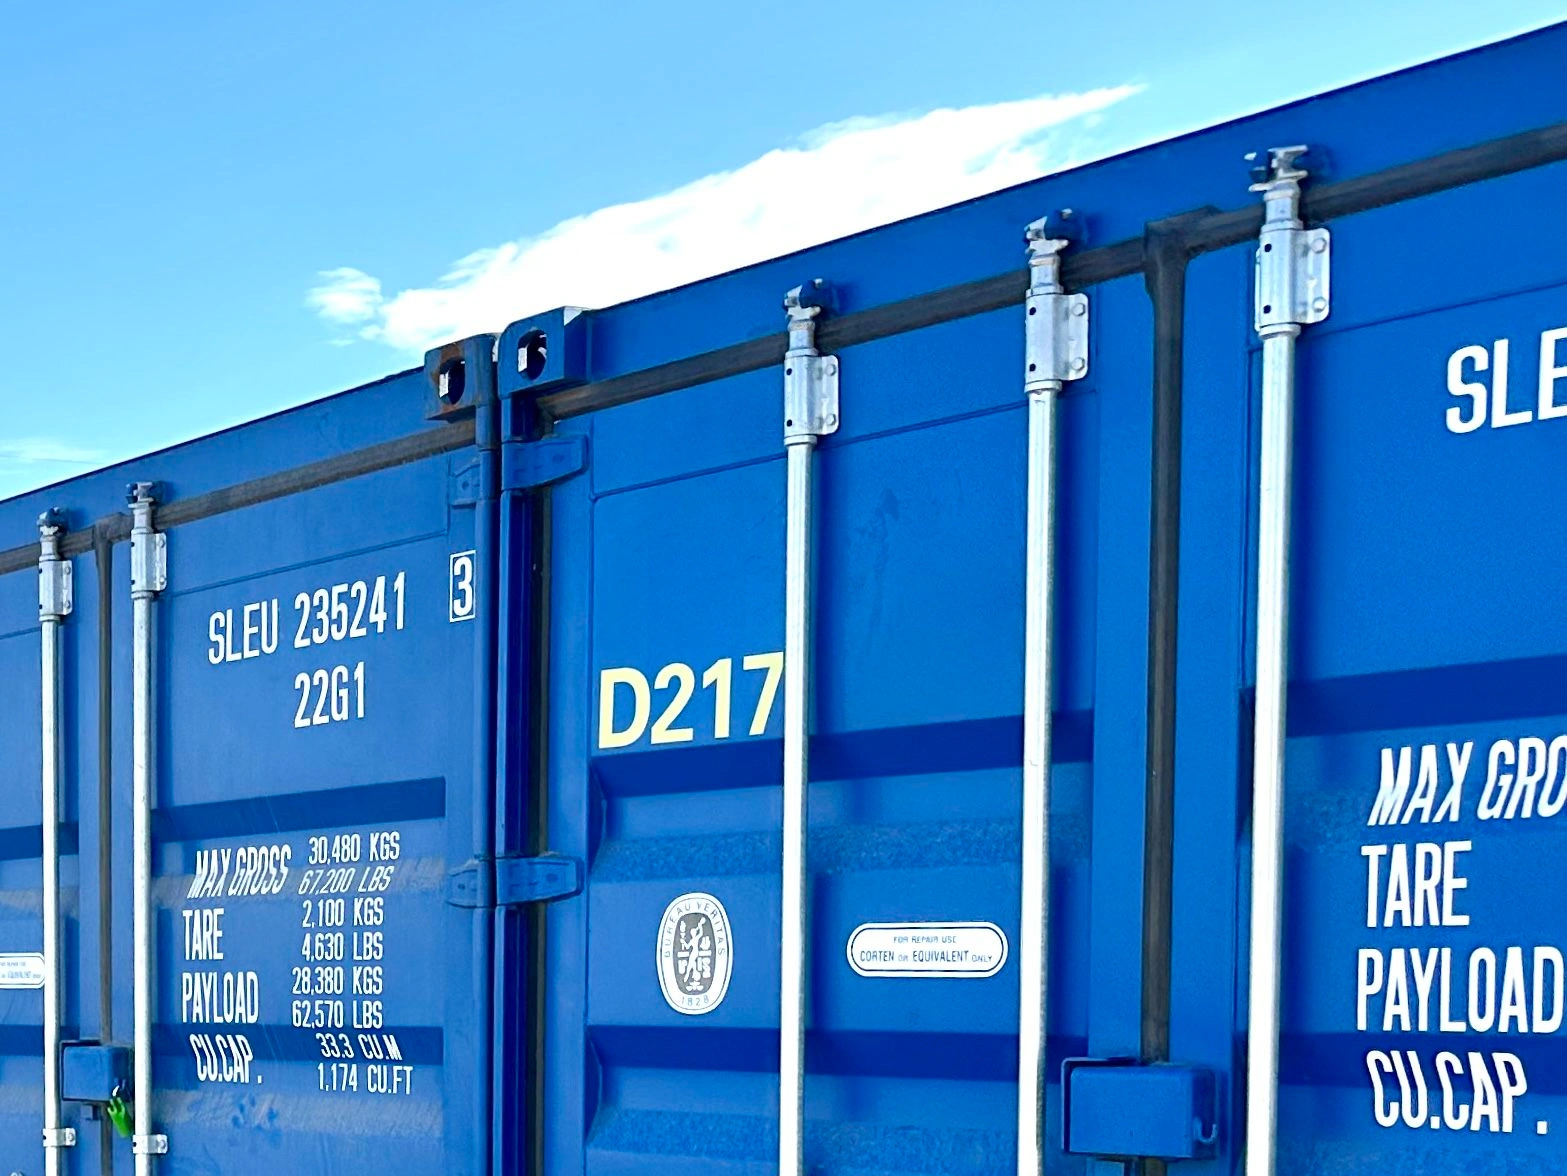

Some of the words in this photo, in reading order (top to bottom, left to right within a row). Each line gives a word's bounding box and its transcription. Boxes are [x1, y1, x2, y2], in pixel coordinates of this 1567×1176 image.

[1446, 326, 1567, 433] SLE
[208, 598, 278, 664] SLEU
[294, 571, 405, 649] 235241
[294, 661, 365, 728] 22G1
[598, 651, 784, 749] D217
[1367, 742, 1474, 826] MAX
[1477, 735, 1567, 820] GRO
[369, 831, 400, 862] KGS
[186, 848, 231, 899] MAX
[228, 844, 292, 897] GROSS
[358, 865, 395, 893] LBS
[1361, 840, 1472, 928] TARE
[353, 897, 384, 926] KGS
[664, 902, 691, 957] BUREAU
[696, 902, 726, 957] VERITAS
[182, 908, 224, 960] TARE
[353, 932, 383, 961] LBS
[893, 936, 908, 944] FOR
[911, 936, 938, 944] REPAIR
[941, 935, 957, 944] USE
[860, 950, 894, 962] CORTEN
[912, 950, 969, 962] EQUIVALENT
[972, 954, 993, 963] ONLY
[182, 971, 259, 1024] PAYLOAD
[352, 966, 383, 994] KGS
[681, 995, 710, 1006] 1828
[1357, 946, 1564, 1033] PAYLOAD
[352, 1000, 383, 1029] LBS
[358, 1034, 403, 1061] CU.M
[367, 1064, 413, 1095] CU.FT
